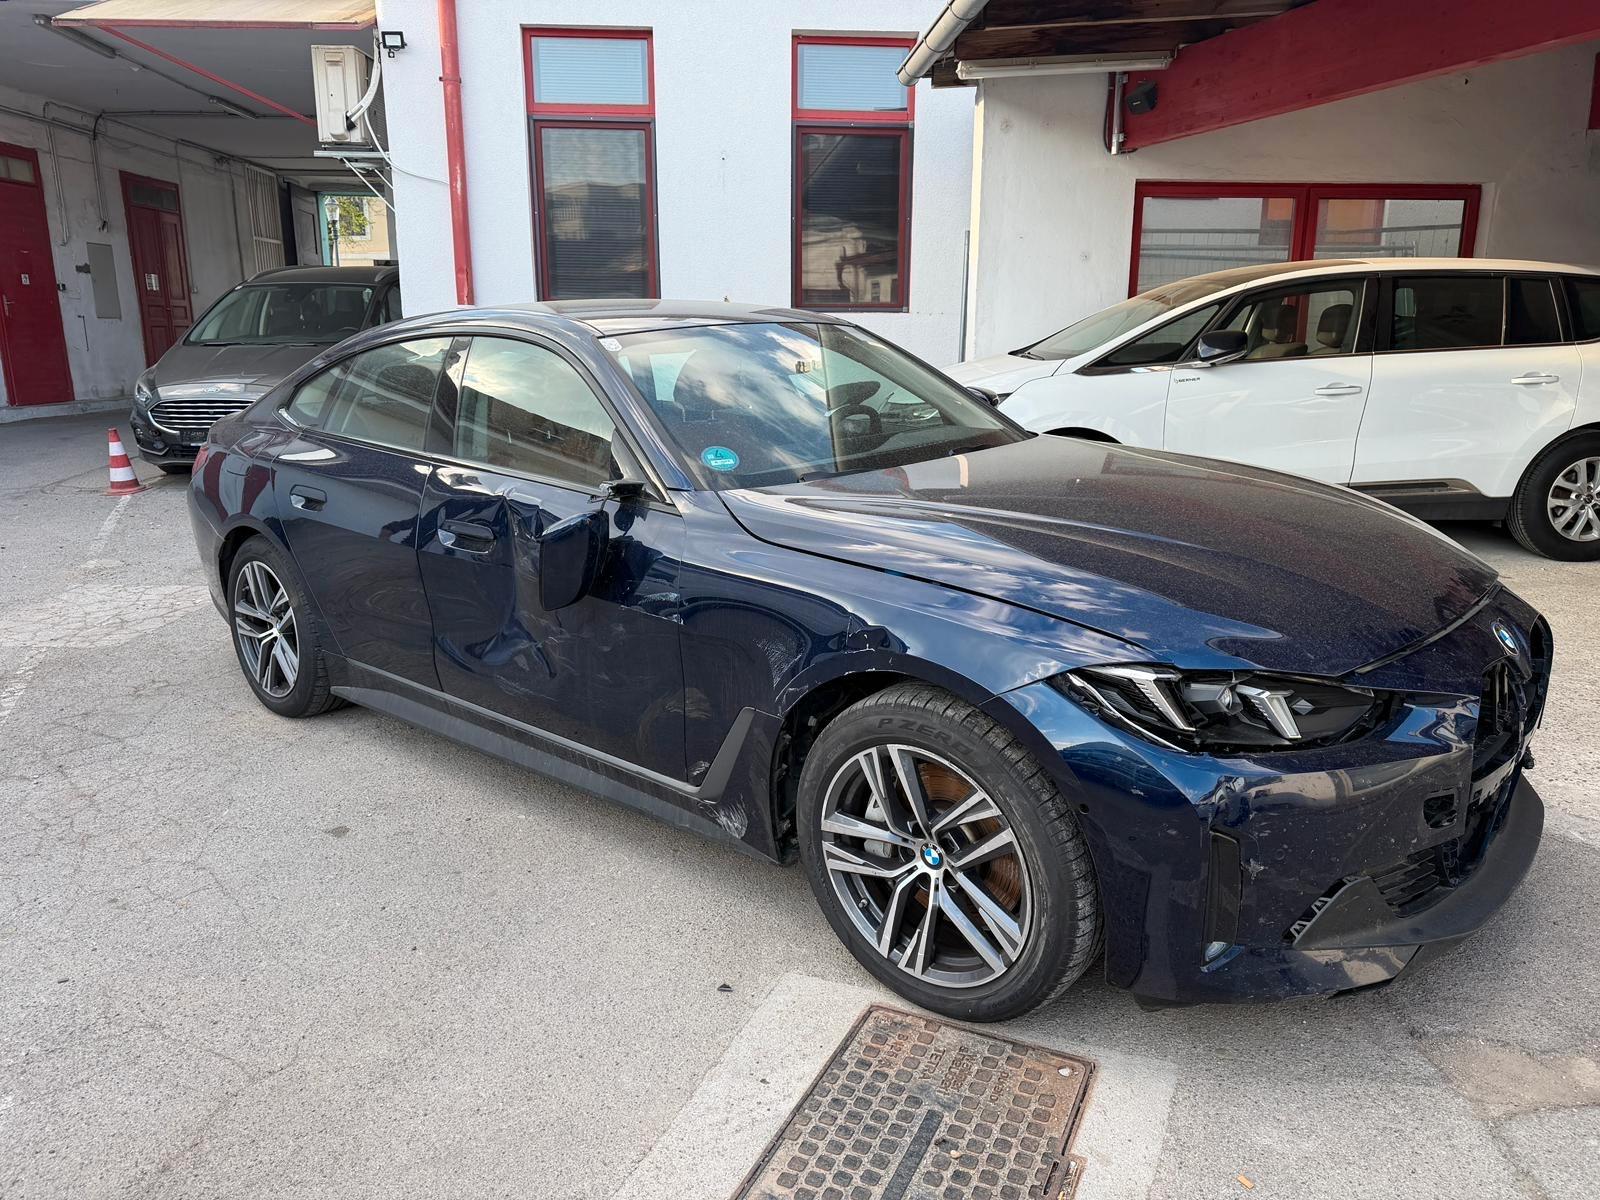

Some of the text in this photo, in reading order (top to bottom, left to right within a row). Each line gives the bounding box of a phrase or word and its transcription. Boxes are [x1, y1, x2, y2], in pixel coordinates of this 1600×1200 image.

[877, 718, 974, 755] P ZERO
[918, 1049, 945, 1080] TETRA
